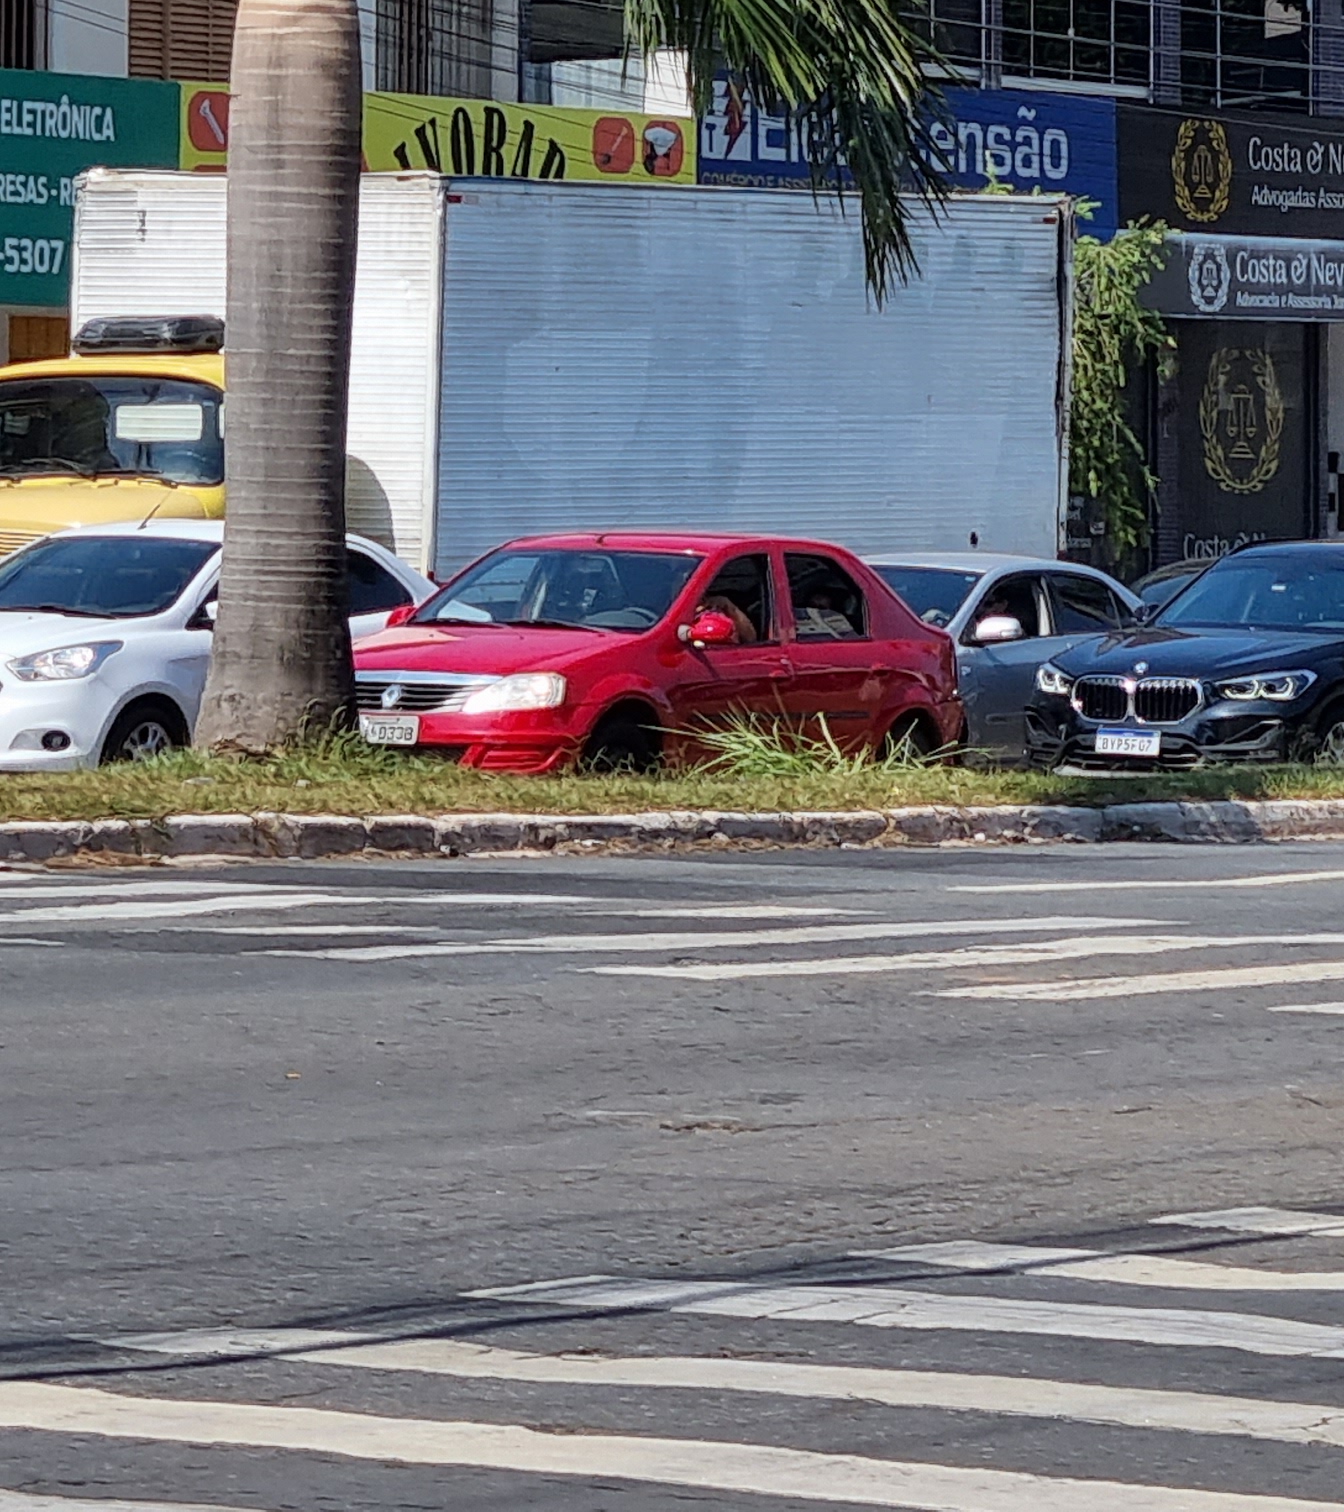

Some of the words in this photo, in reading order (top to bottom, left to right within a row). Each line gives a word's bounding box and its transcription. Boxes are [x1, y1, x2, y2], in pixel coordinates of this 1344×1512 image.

[0, 94, 115, 142] ELETRÔNICA
[1249, 137, 1302, 172] Costa
[1236, 250, 1287, 284] Costa
